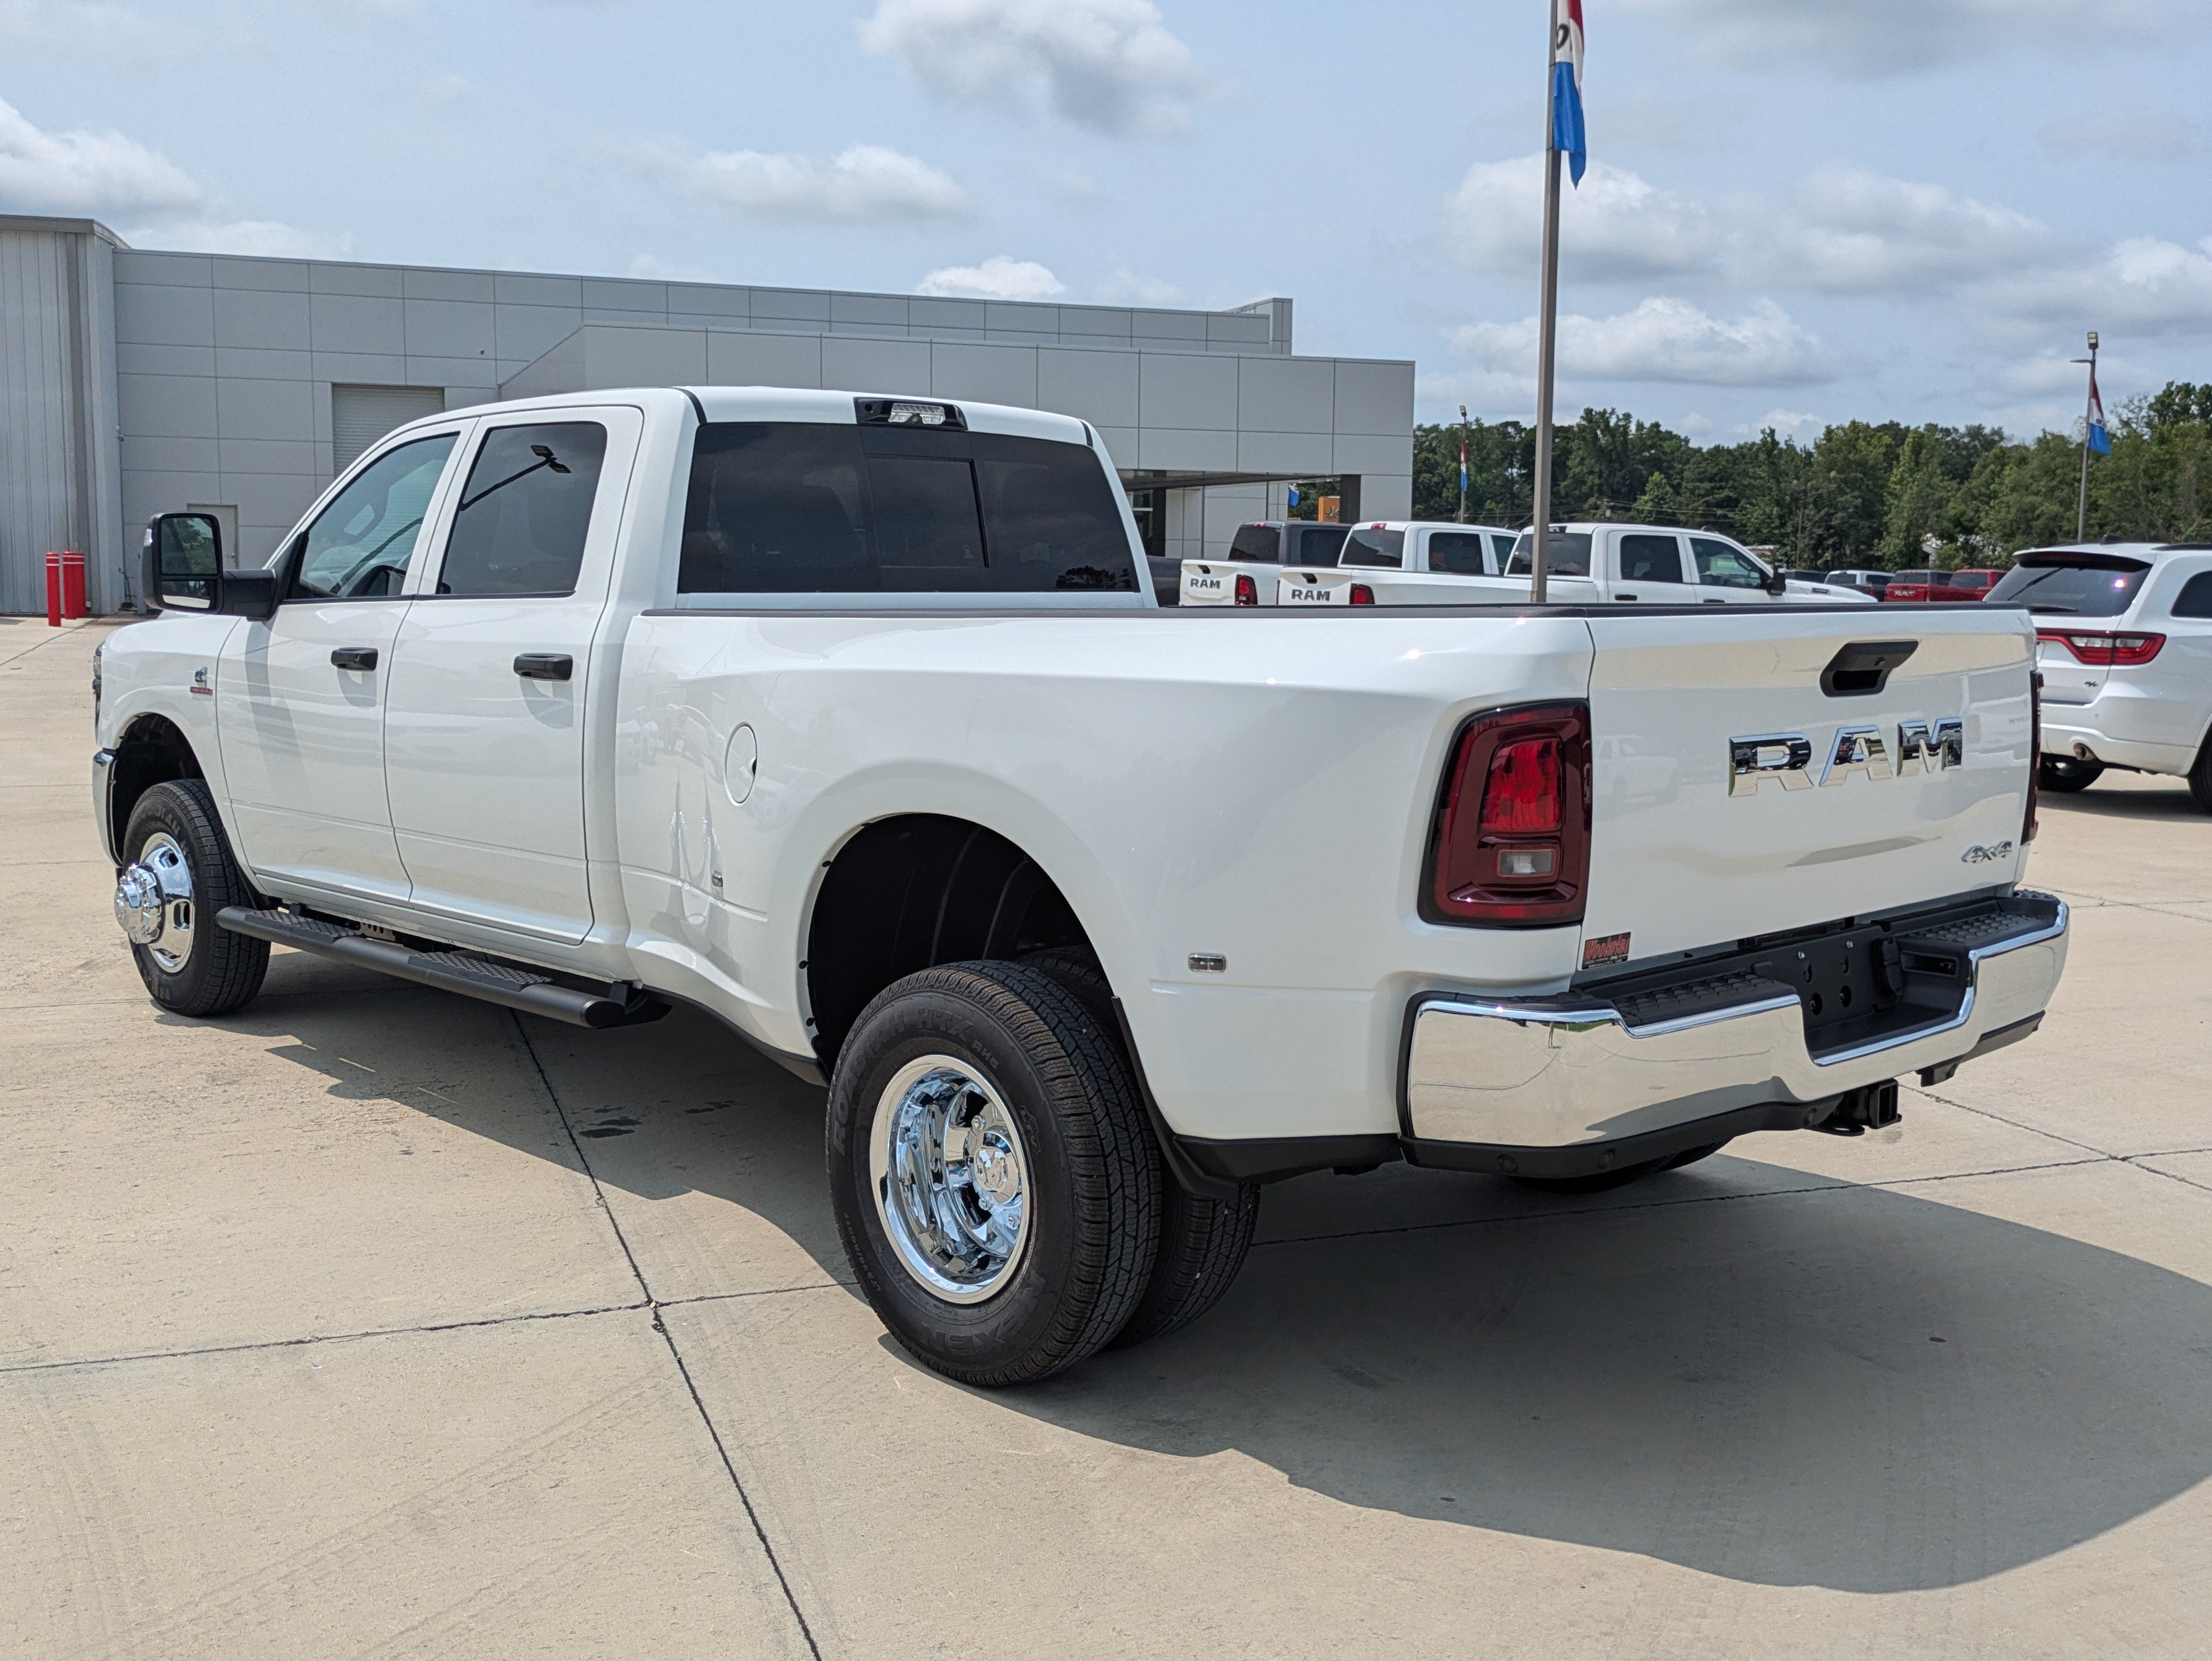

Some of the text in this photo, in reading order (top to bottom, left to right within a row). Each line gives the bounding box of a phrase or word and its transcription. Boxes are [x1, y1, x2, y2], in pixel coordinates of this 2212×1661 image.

[1190, 577, 1221, 589] RAM
[1292, 588, 1331, 602] RAM
[1728, 717, 1962, 797] RAM
[916, 1008, 973, 1042] HTX
